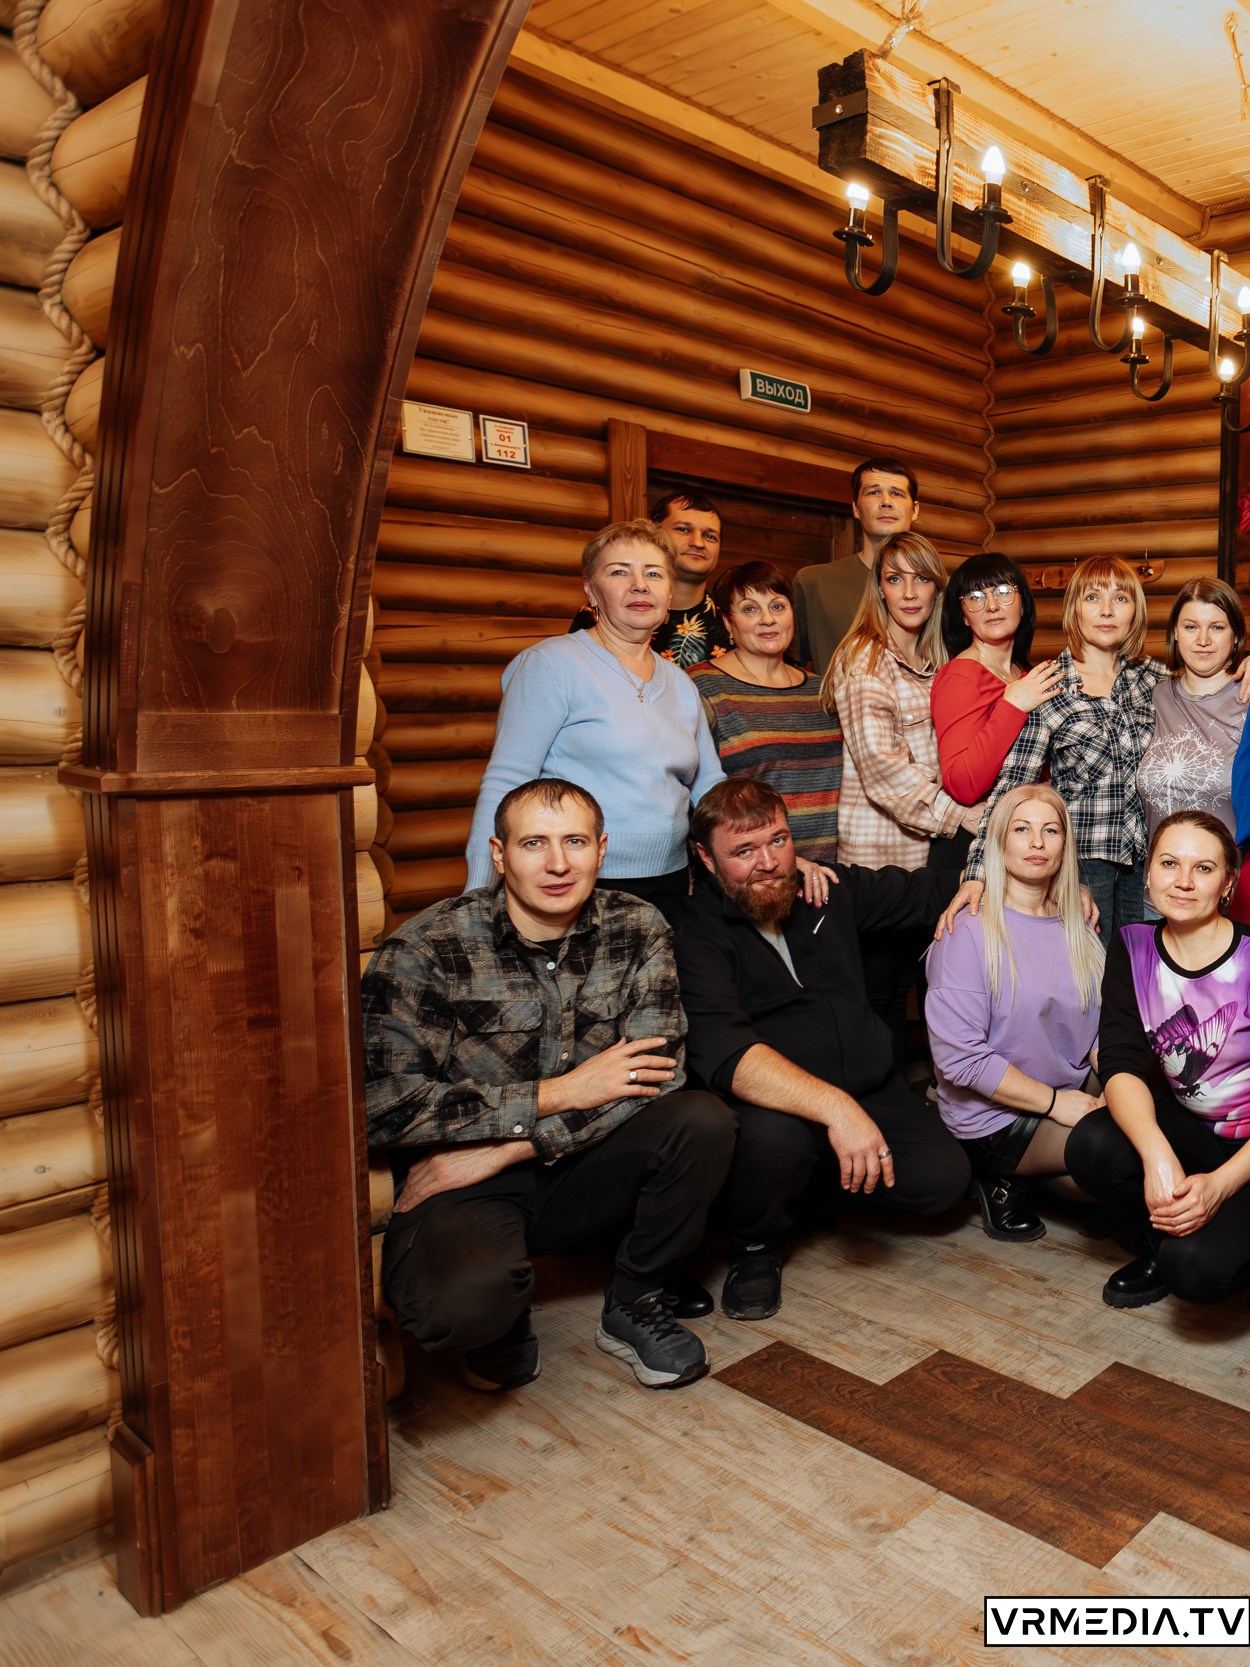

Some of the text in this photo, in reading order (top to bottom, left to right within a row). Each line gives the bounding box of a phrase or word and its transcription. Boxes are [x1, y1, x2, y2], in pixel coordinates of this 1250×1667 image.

[755, 378, 805, 406] ВЫХОД
[499, 434, 511, 443] 01
[496, 449, 516, 459] 112
